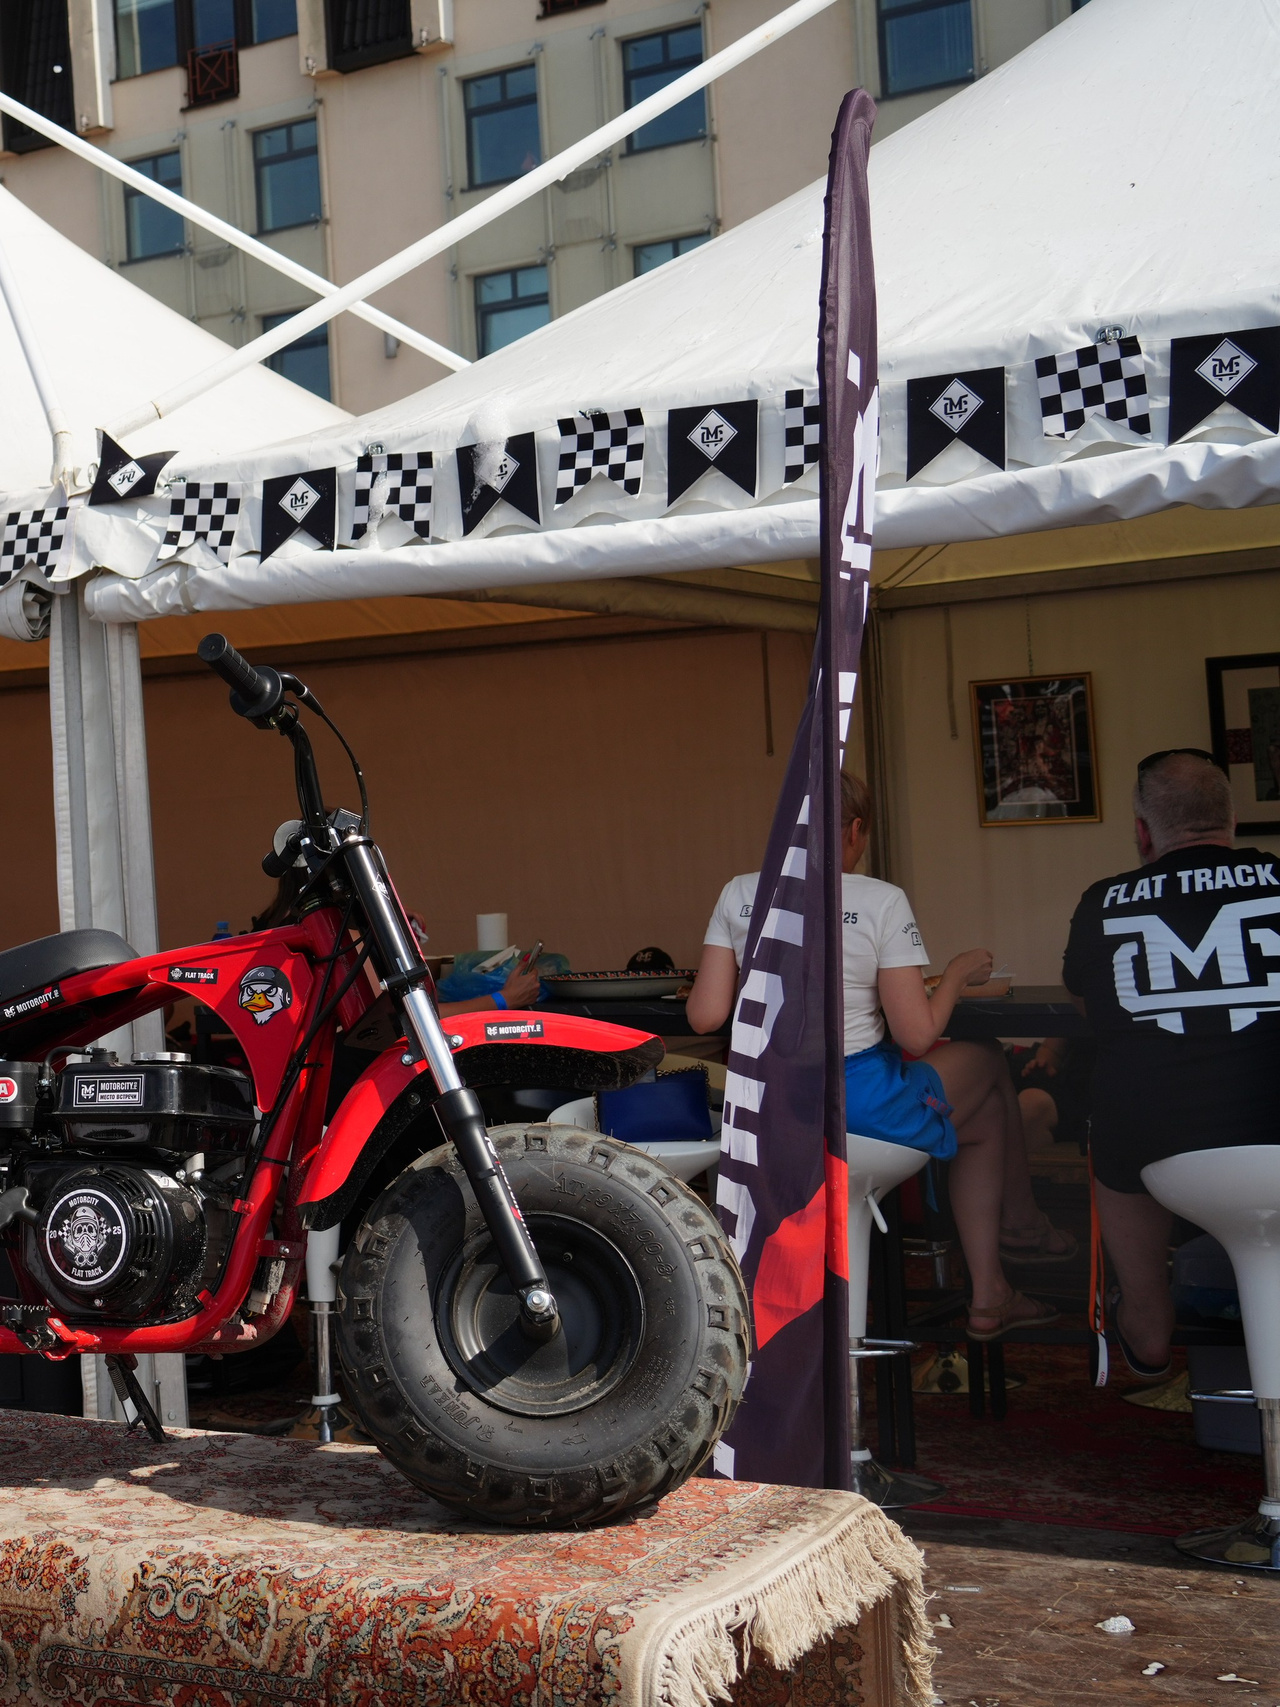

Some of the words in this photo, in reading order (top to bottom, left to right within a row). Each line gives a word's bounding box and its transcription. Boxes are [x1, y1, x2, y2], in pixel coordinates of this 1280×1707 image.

[1103, 874, 1167, 908] FLAT
[1177, 863, 1280, 894] TRACK
[185, 971, 197, 979] FLAT
[197, 972, 214, 980] TRACK
[68, 1195, 100, 1208] MOTORCITY
[49, 1230, 58, 1239] 20
[112, 1225, 121, 1235] 25
[71, 1267, 84, 1278] FLAT
[84, 1266, 104, 1278] TRACK
